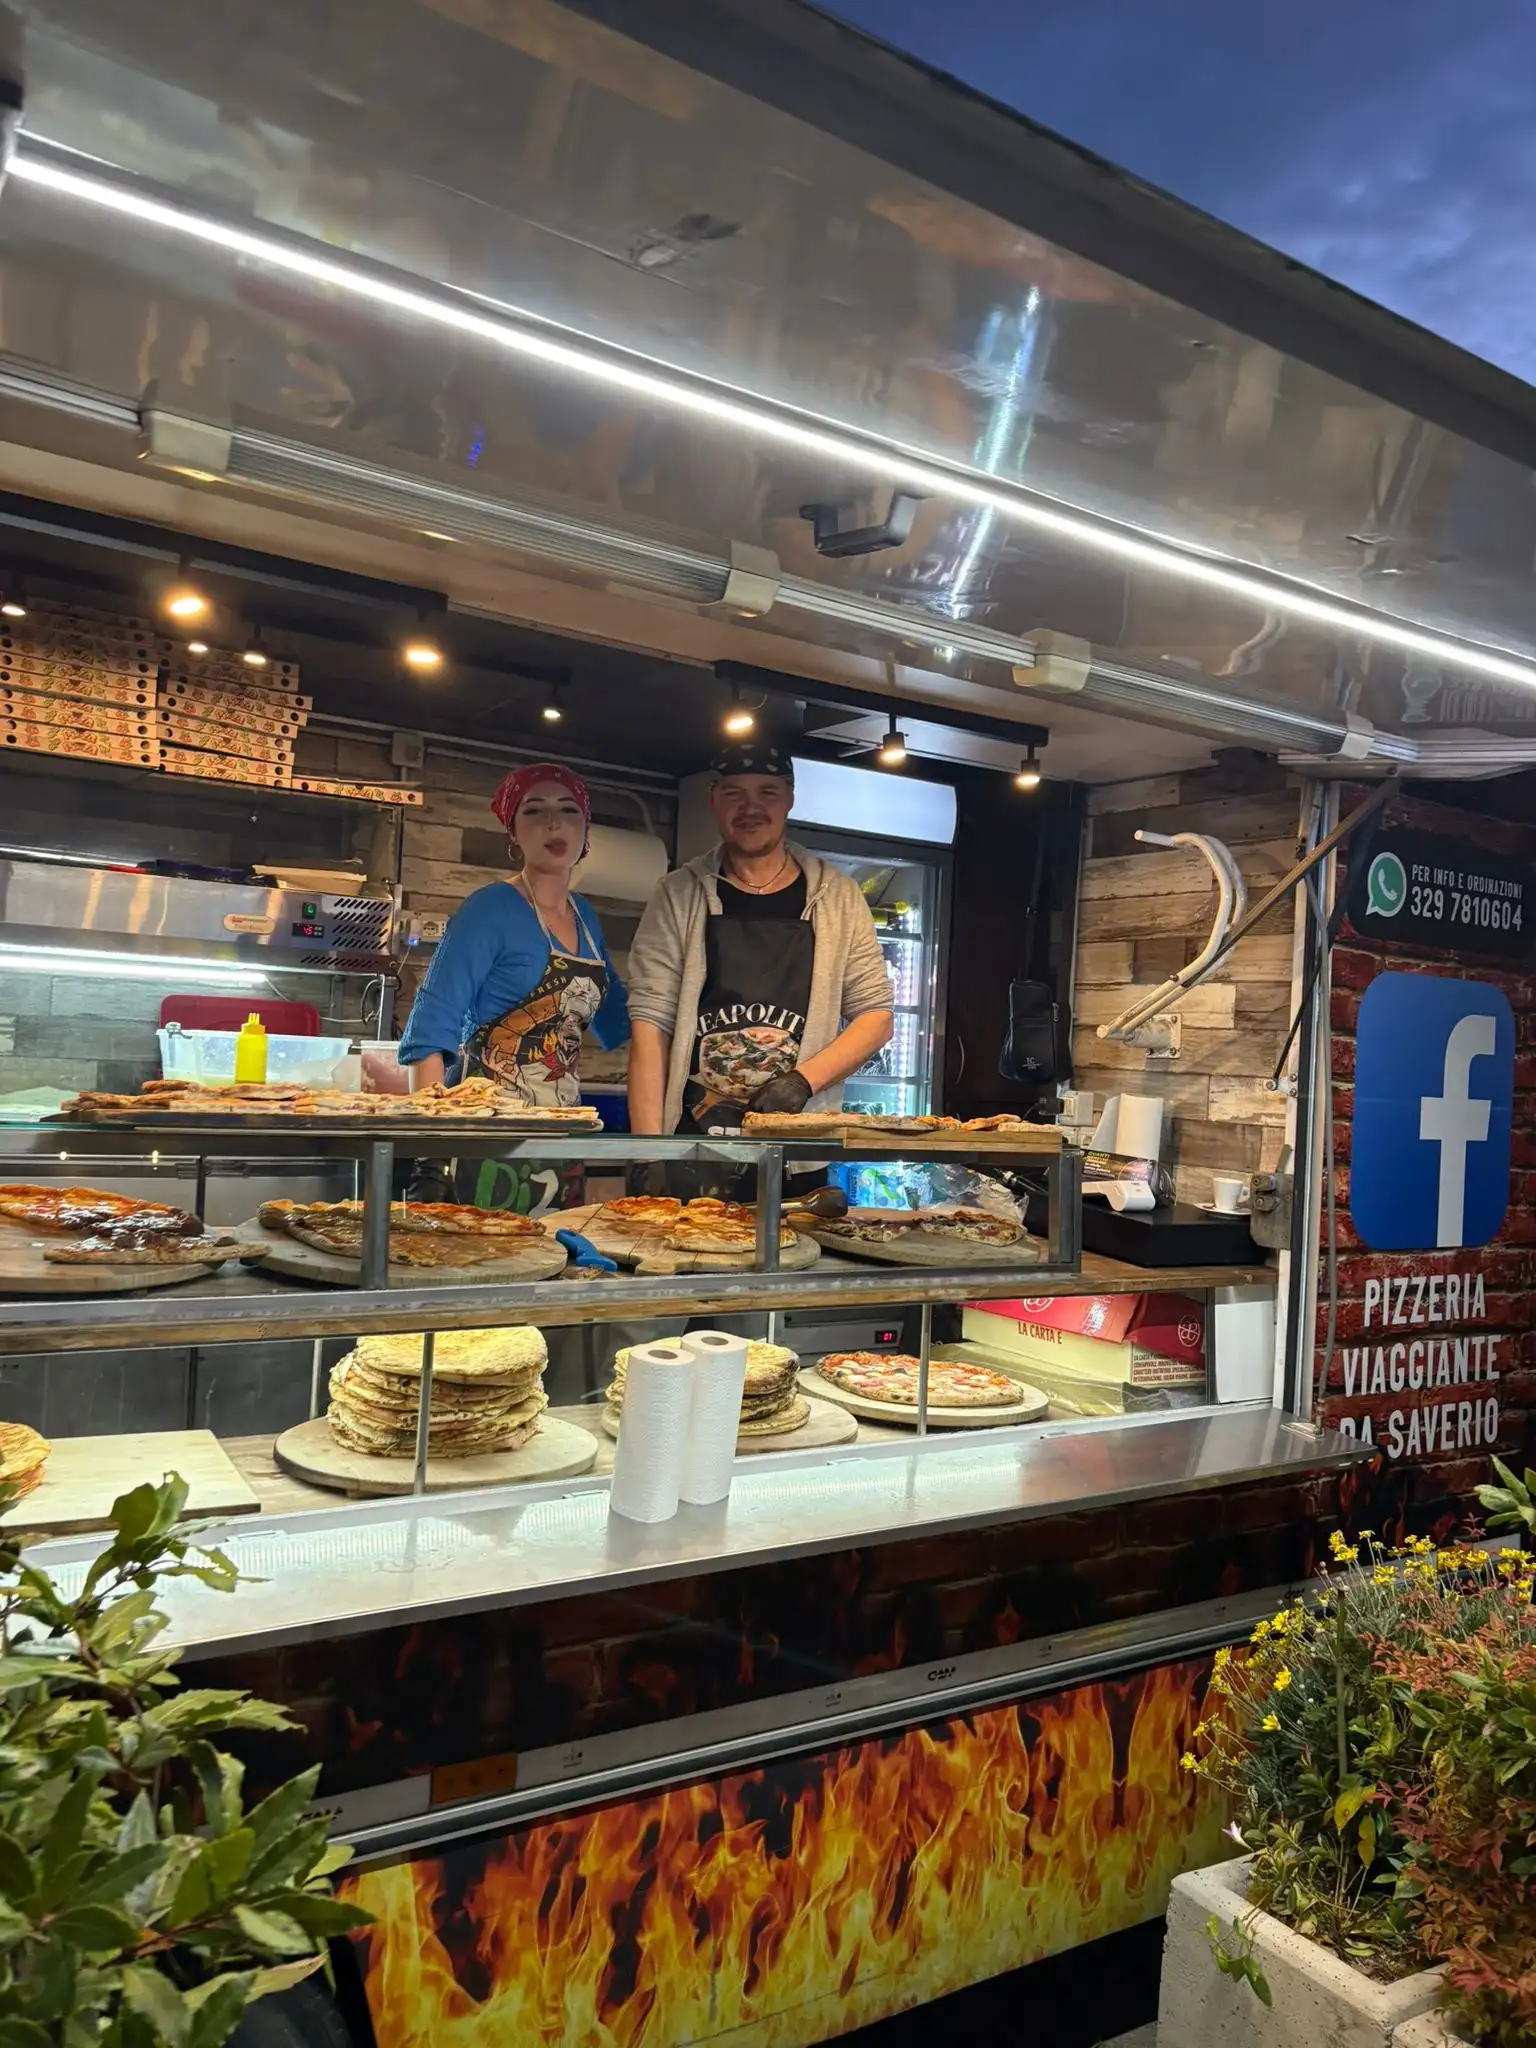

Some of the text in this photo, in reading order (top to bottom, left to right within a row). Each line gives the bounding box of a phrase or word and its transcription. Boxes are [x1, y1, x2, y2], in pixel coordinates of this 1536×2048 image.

[1412, 864, 1522, 899] PER INFO E ORDINAZIONI
[1411, 886, 1522, 932] 329 7810604
[697, 1003, 805, 1037] EAPOLIT
[1363, 1273, 1486, 1327] PIZZERIA
[1017, 1321, 1027, 1336] LA
[1030, 1324, 1055, 1343] CARTA
[1342, 1335, 1501, 1398] VIAGGIANTE
[1387, 1397, 1499, 1459] SAVERIO
